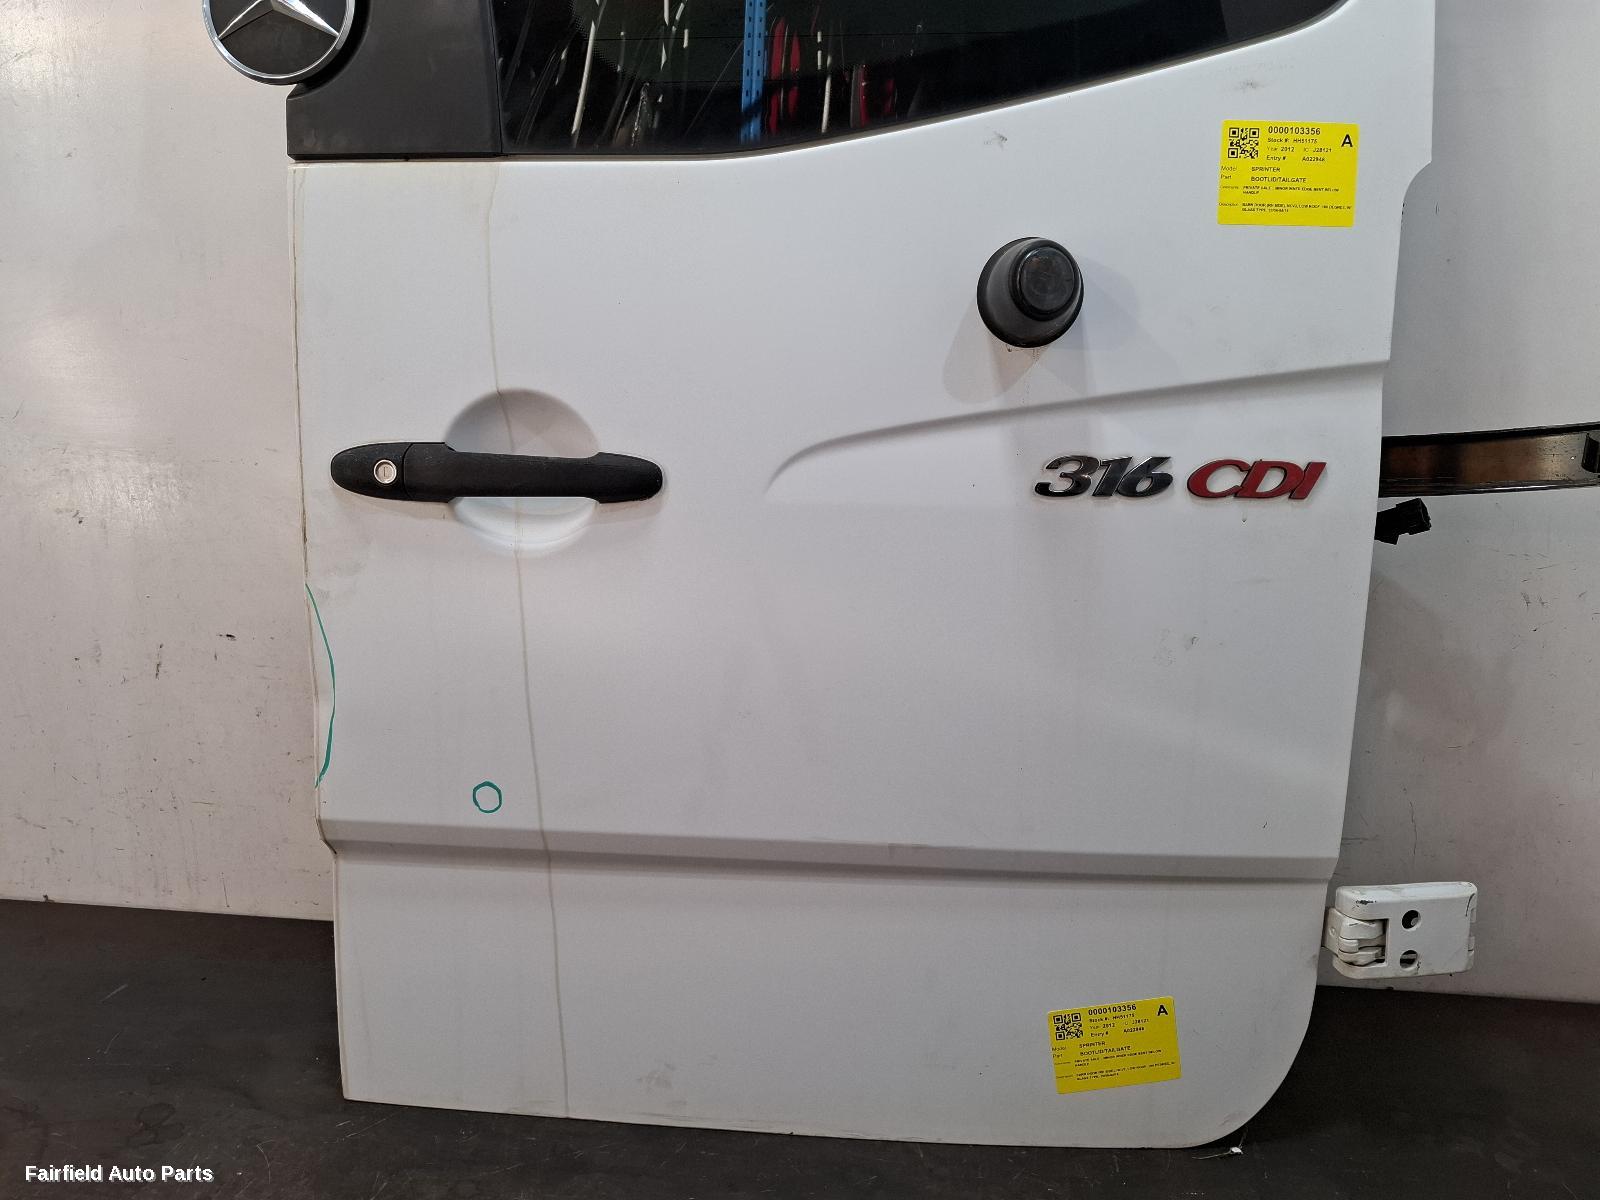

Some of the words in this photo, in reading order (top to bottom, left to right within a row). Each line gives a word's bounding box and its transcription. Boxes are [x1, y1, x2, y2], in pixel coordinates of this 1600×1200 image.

[1268, 126, 1321, 135] 0000103356
[1341, 133, 1353, 147] A
[1034, 455, 1174, 497] 316
[1187, 458, 1327, 500] CDI
[1088, 1003, 1137, 1016] 0000103356
[1157, 1004, 1169, 1017] A
[1079, 1041, 1106, 1049] SPRINTER
